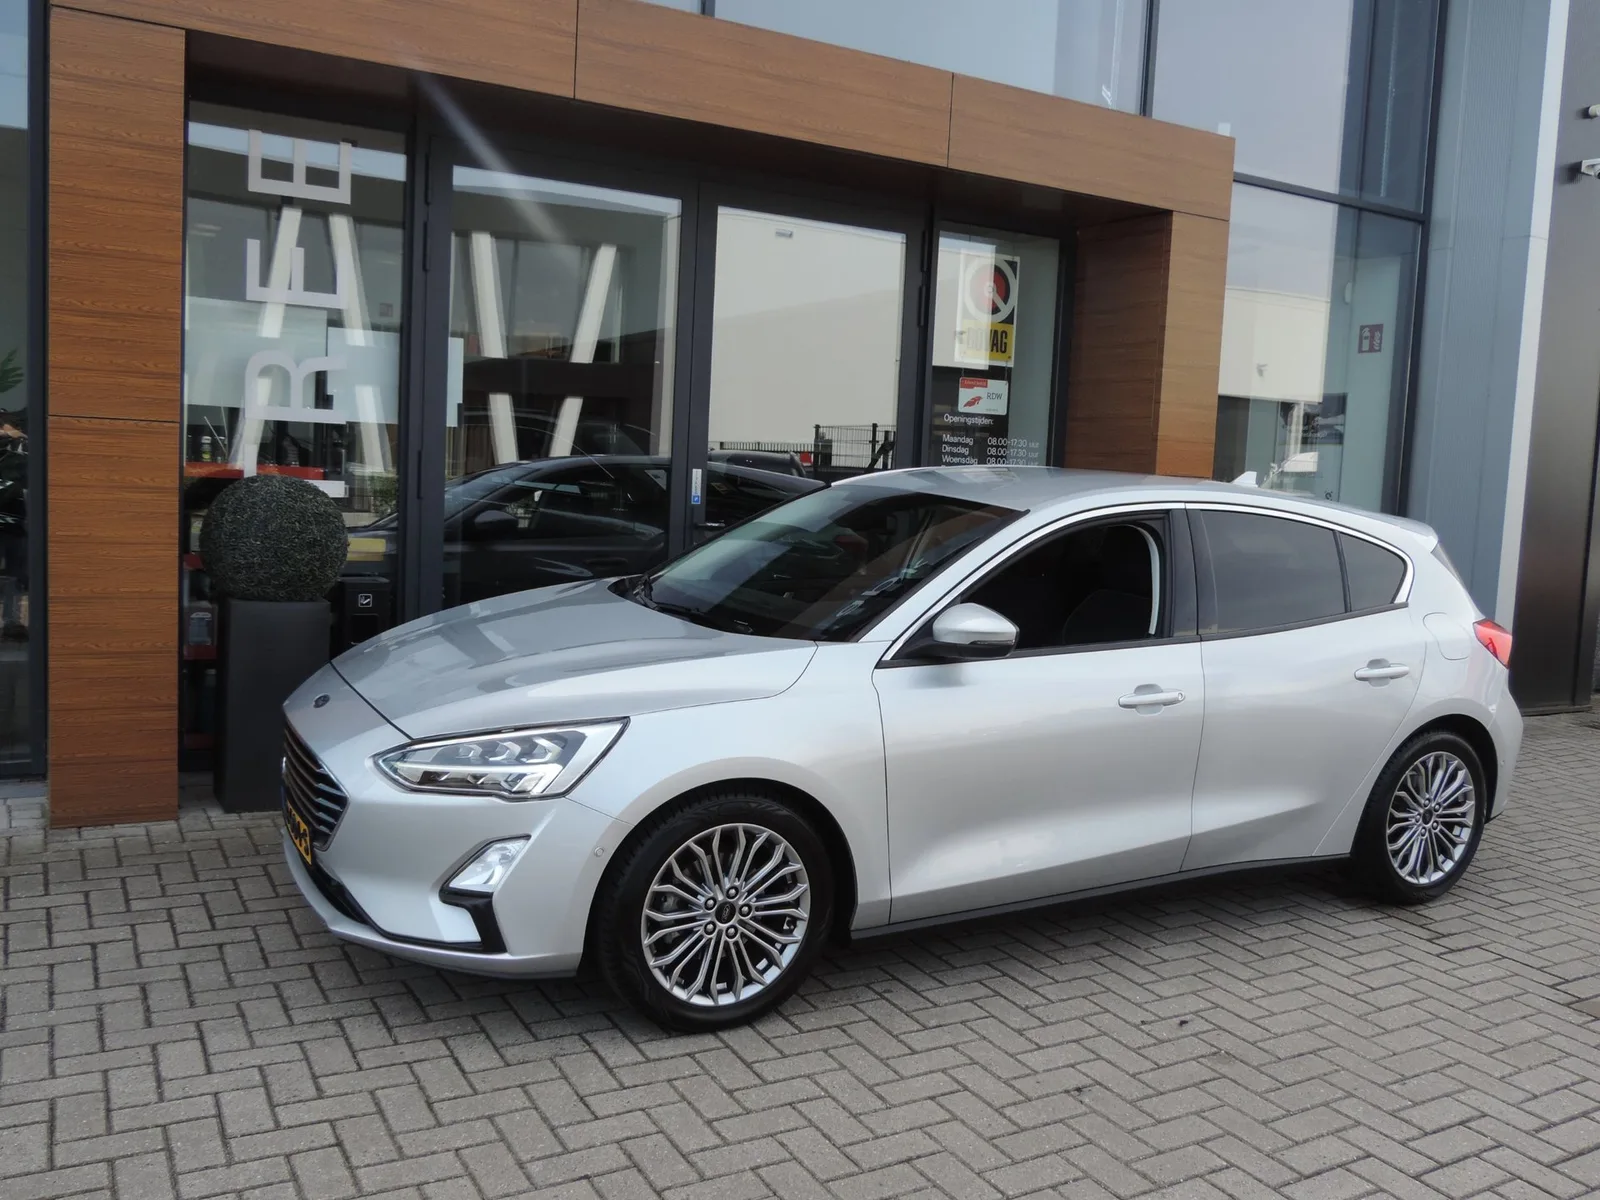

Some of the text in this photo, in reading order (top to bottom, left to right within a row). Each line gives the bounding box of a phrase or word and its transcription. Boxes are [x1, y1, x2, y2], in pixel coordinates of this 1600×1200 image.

[986, 392, 1003, 400] RDW
[943, 413, 994, 426] Openingstijden:
[942, 434, 974, 445] Maandag
[941, 444, 969, 455] Dinsdag
[941, 455, 978, 466] Woensdag
